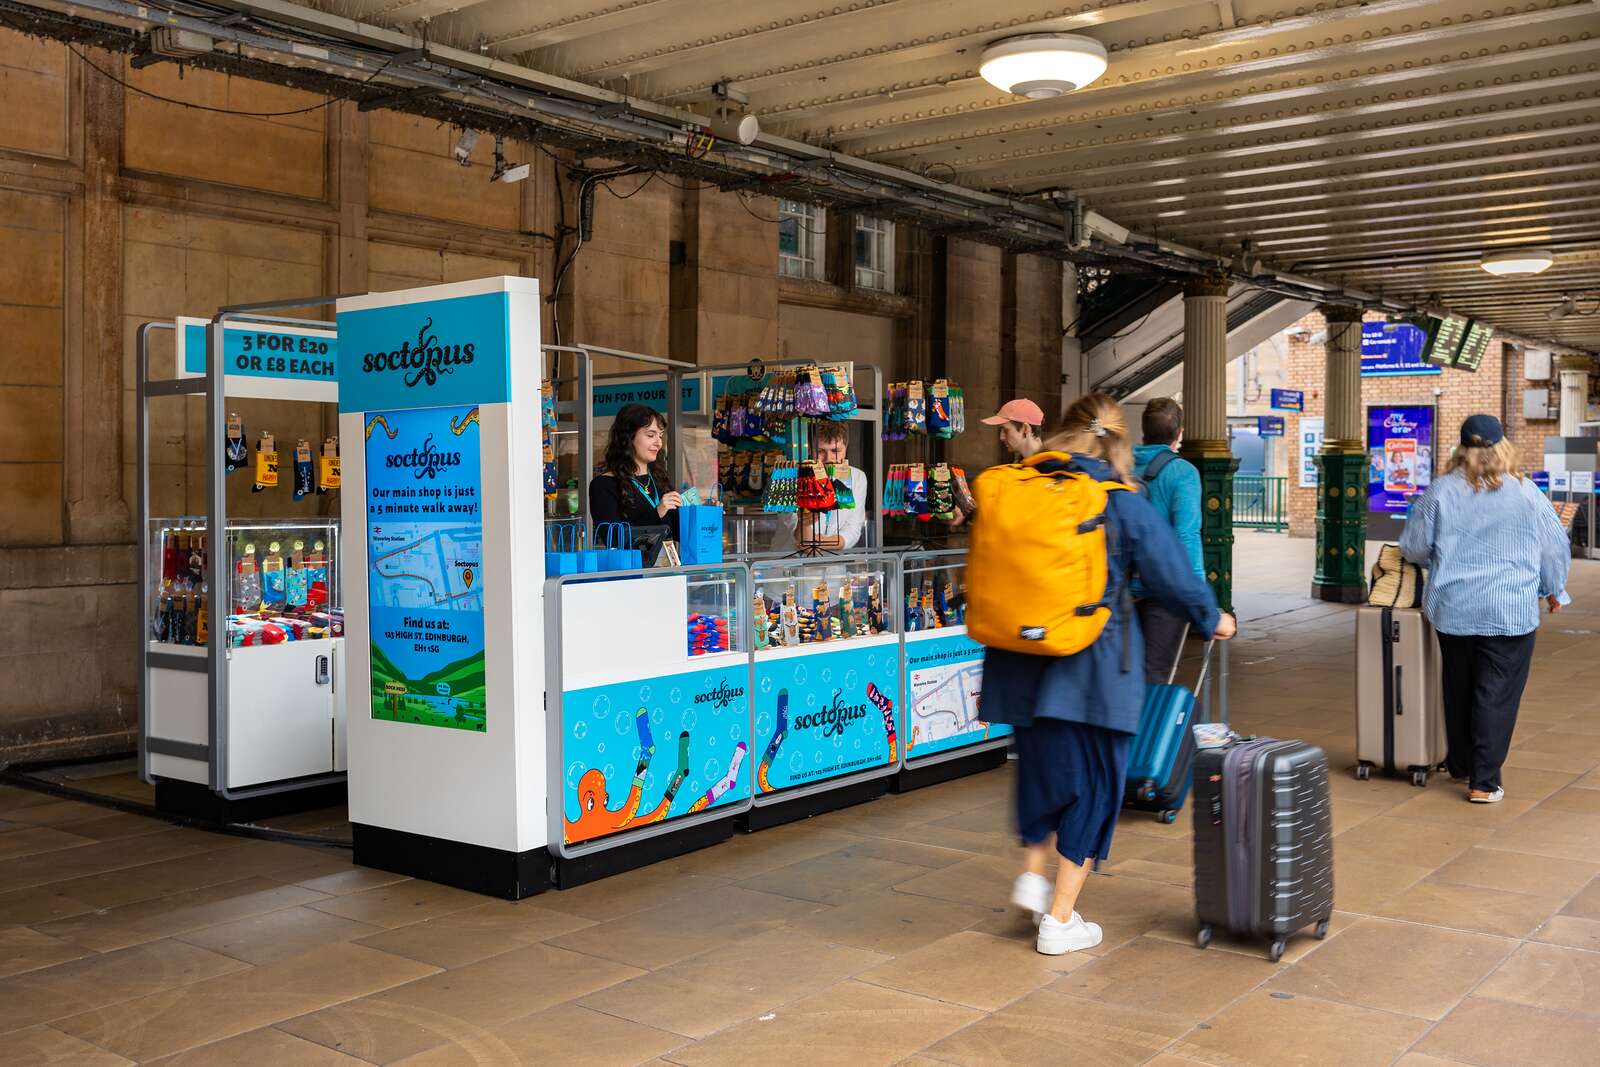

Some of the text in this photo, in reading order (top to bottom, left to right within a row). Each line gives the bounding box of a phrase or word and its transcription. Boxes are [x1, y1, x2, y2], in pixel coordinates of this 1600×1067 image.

[242, 334, 328, 354] 3 FOR £20
[362, 316, 475, 388] soctopus
[236, 355, 334, 376] OR £8 EACH
[593, 394, 612, 404] FUN
[615, 392, 634, 402] FOR
[637, 390, 666, 400] YOUR
[385, 433, 461, 479] soctopus
[372, 486, 475, 498] Our main shop is just
[370, 502, 478, 515] a 5 minute walk away!
[454, 560, 479, 568] Soctopus
[404, 616, 450, 630] Find us at:
[396, 631, 413, 640] HIGH
[414, 632, 424, 640] ST.
[425, 632, 469, 645] EDINBURGH,
[414, 644, 440, 653] EH1 1SG
[953, 650, 963, 658] just
[694, 676, 744, 708] soctopus
[794, 688, 867, 738] soctopus
